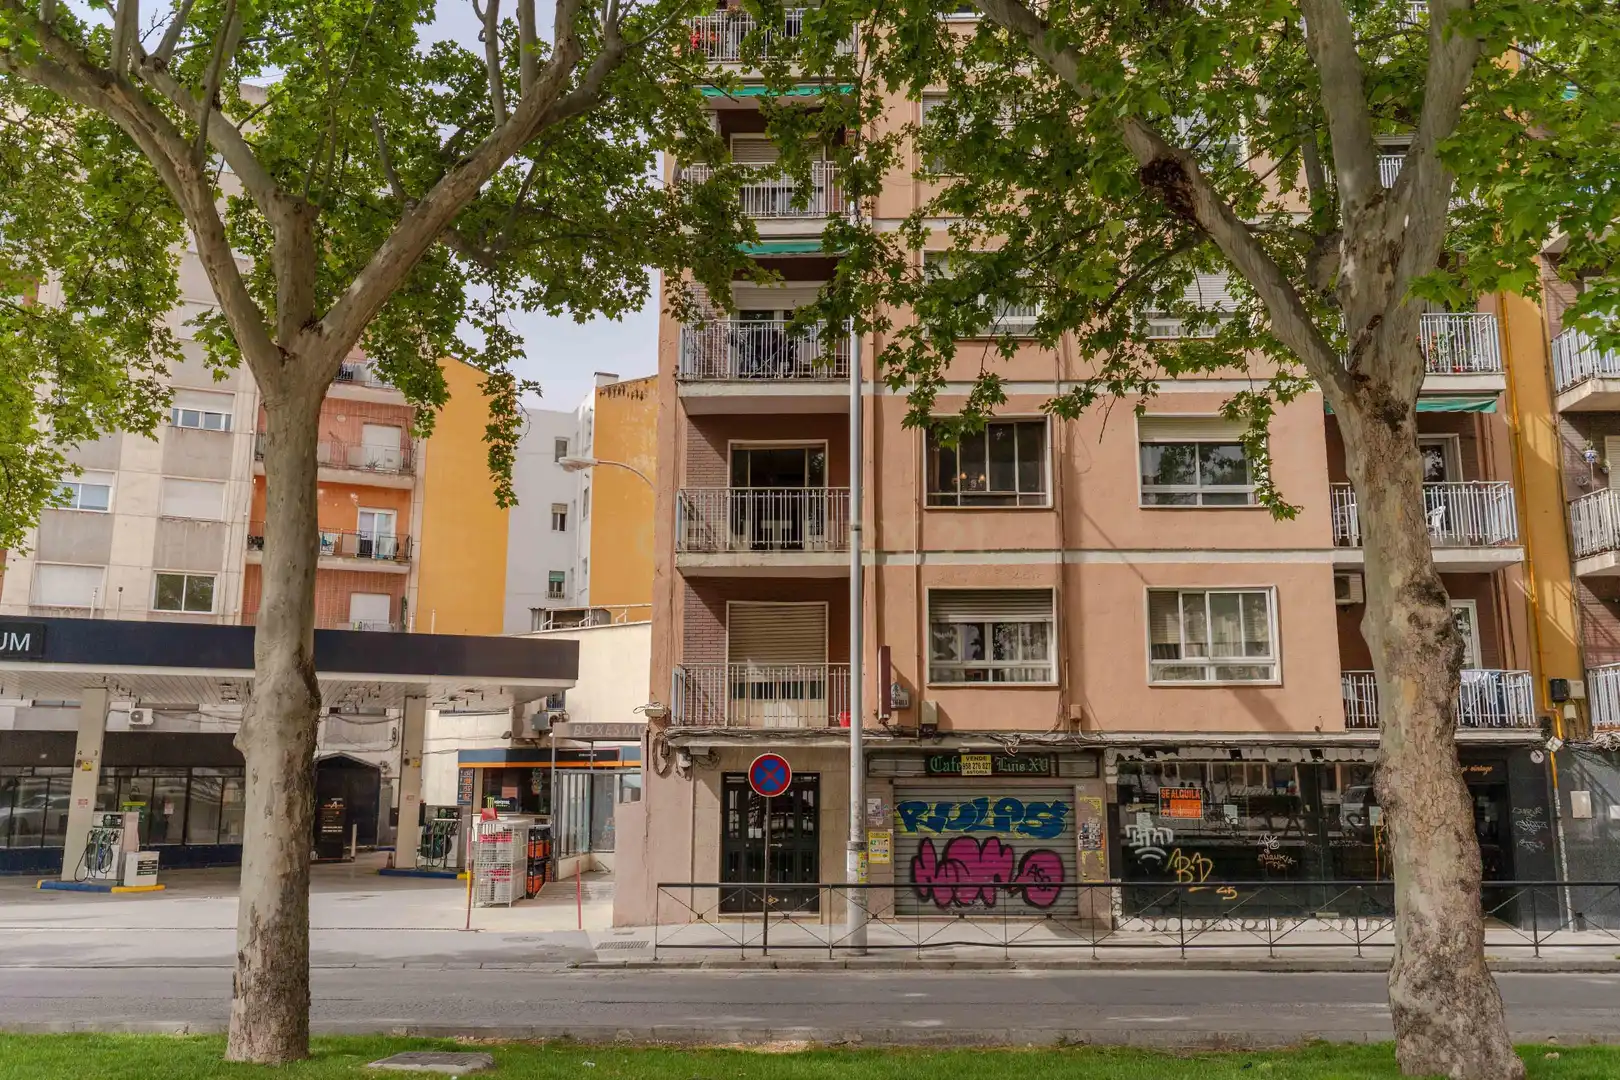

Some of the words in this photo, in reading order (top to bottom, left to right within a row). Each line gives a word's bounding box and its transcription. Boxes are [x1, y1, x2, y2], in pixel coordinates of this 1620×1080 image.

[573, 724, 620, 736] BOXES
[994, 755, 1026, 772] Luis
[1161, 789, 1170, 799] SE
[1171, 789, 1201, 799] ALQUILA
